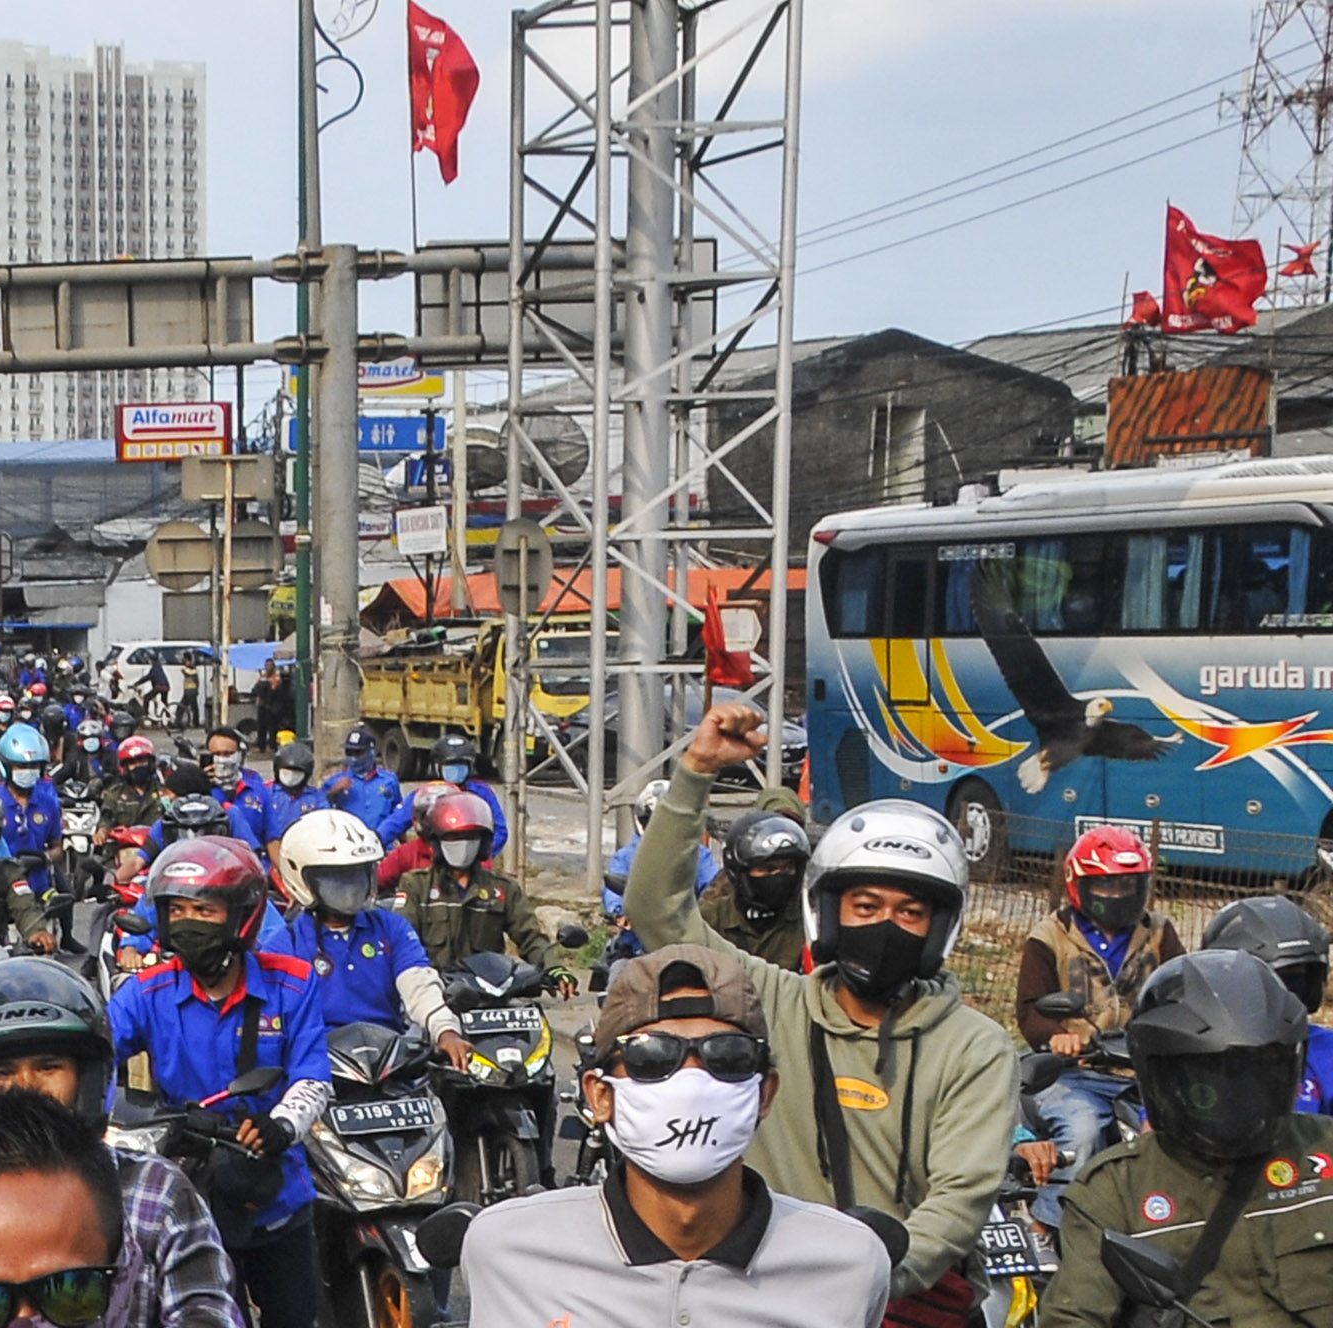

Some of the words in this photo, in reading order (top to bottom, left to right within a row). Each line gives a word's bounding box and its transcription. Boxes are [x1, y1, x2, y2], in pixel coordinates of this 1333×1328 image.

[358, 361, 417, 377] omaret
[131, 409, 216, 425] Alfamart
[1200, 660, 1305, 696] garuda
[872, 840, 921, 854] INK
[337, 1109, 348, 1122] B
[354, 1105, 392, 1121] 3196
[400, 1101, 429, 1116] TLH
